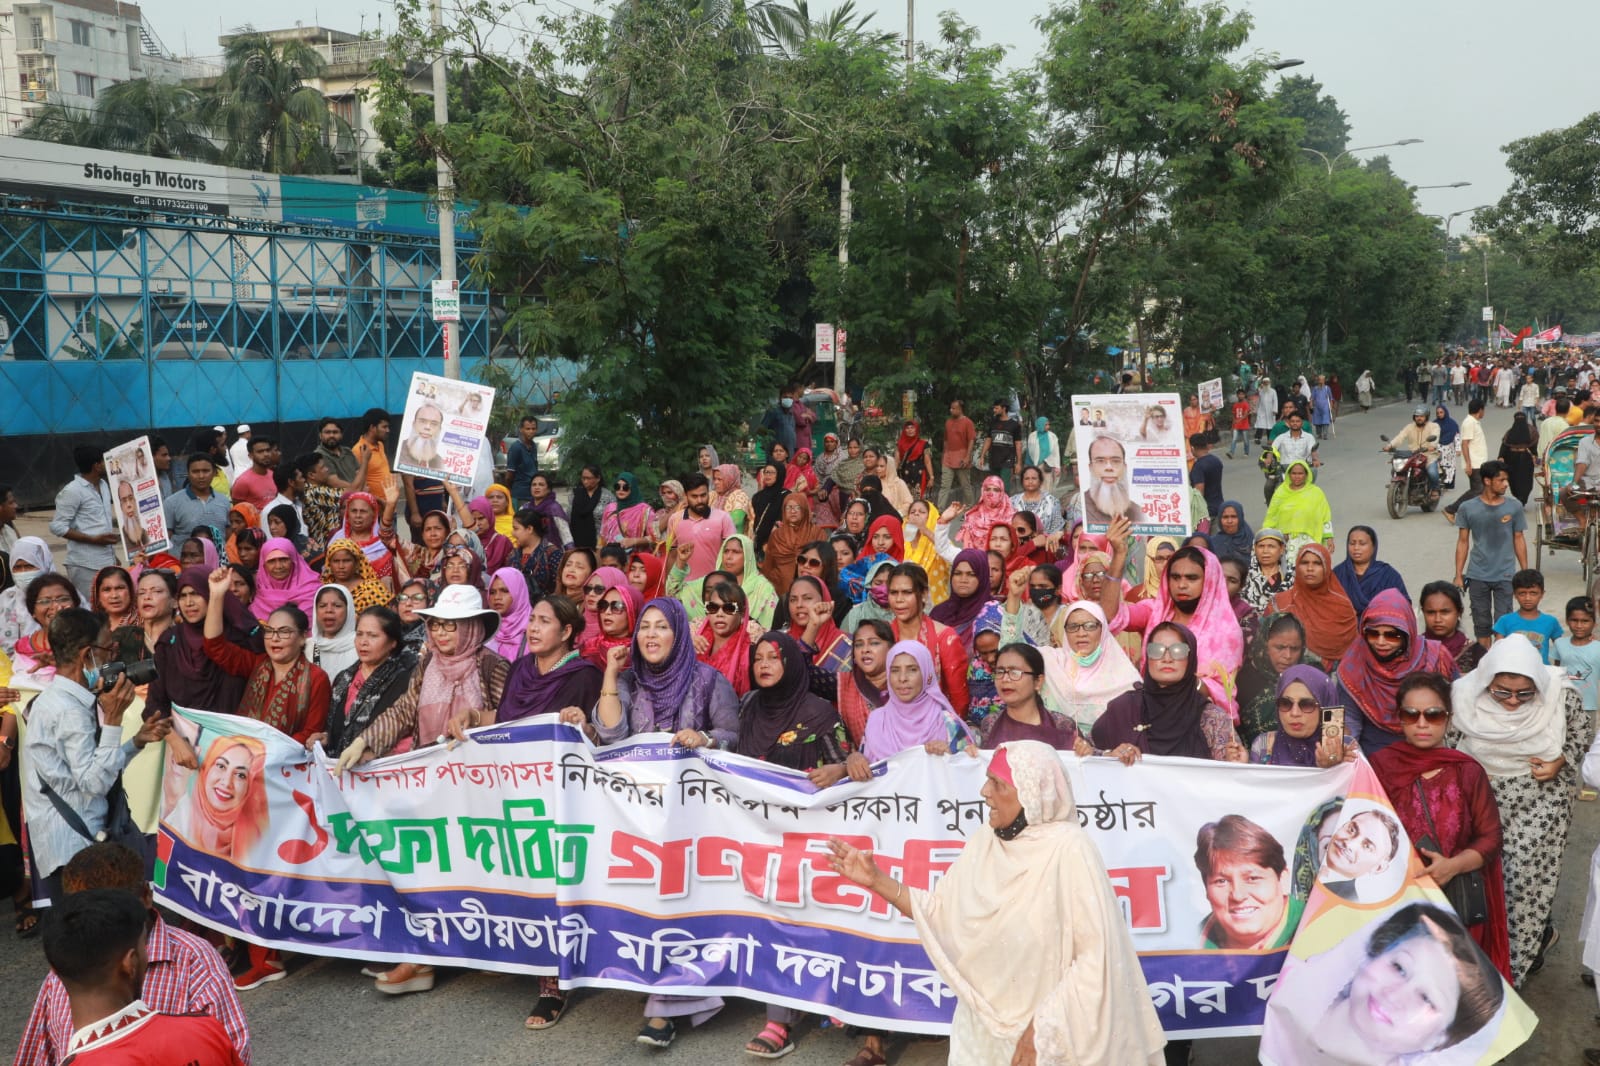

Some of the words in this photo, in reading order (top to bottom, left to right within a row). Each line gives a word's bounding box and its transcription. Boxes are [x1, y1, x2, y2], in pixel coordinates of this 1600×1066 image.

[84, 163, 151, 187] Shohagh
[155, 170, 207, 192] Motors
[133, 196, 150, 205] Call
[176, 860, 389, 940] বাংলাদেশ
[608, 927, 762, 979] মহিলা
